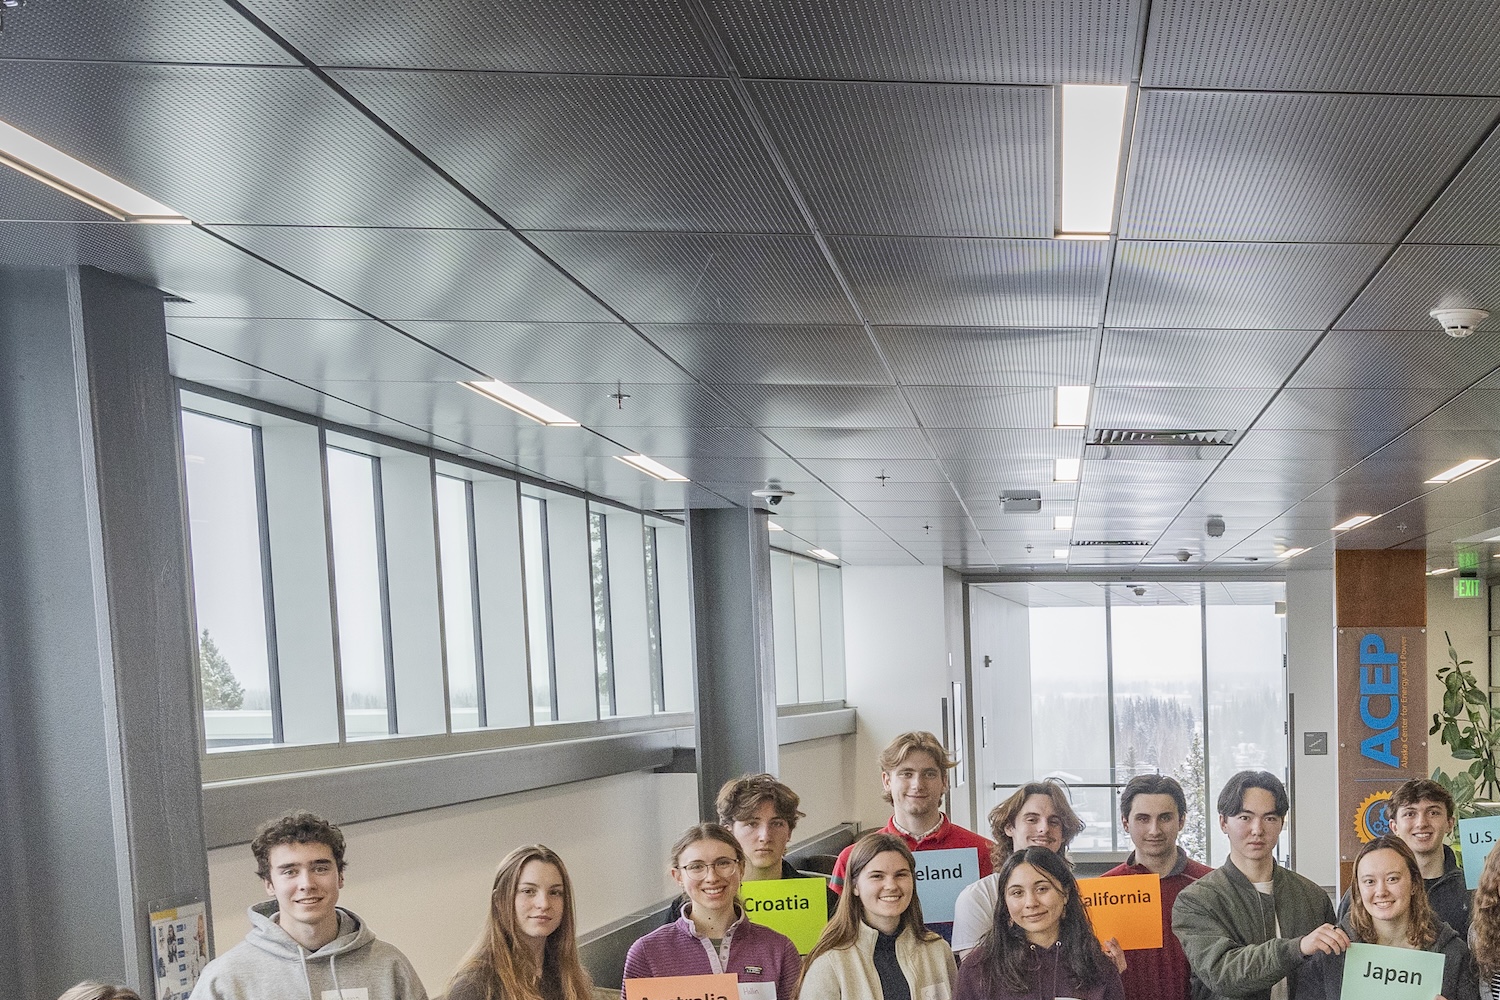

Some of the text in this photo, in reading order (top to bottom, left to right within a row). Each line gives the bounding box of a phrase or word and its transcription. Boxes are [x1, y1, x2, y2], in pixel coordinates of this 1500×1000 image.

[1459, 580, 1480, 596] EXIT
[1360, 633, 1399, 768] ACEP
[1400, 636, 1409, 768] Alaska Center for Energy and Power
[1469, 830, 1497, 845] U.S.
[915, 863, 963, 881] eland
[744, 894, 809, 912] Croatia
[1084, 889, 1151, 907] alifornia
[1363, 961, 1422, 986] Japan
